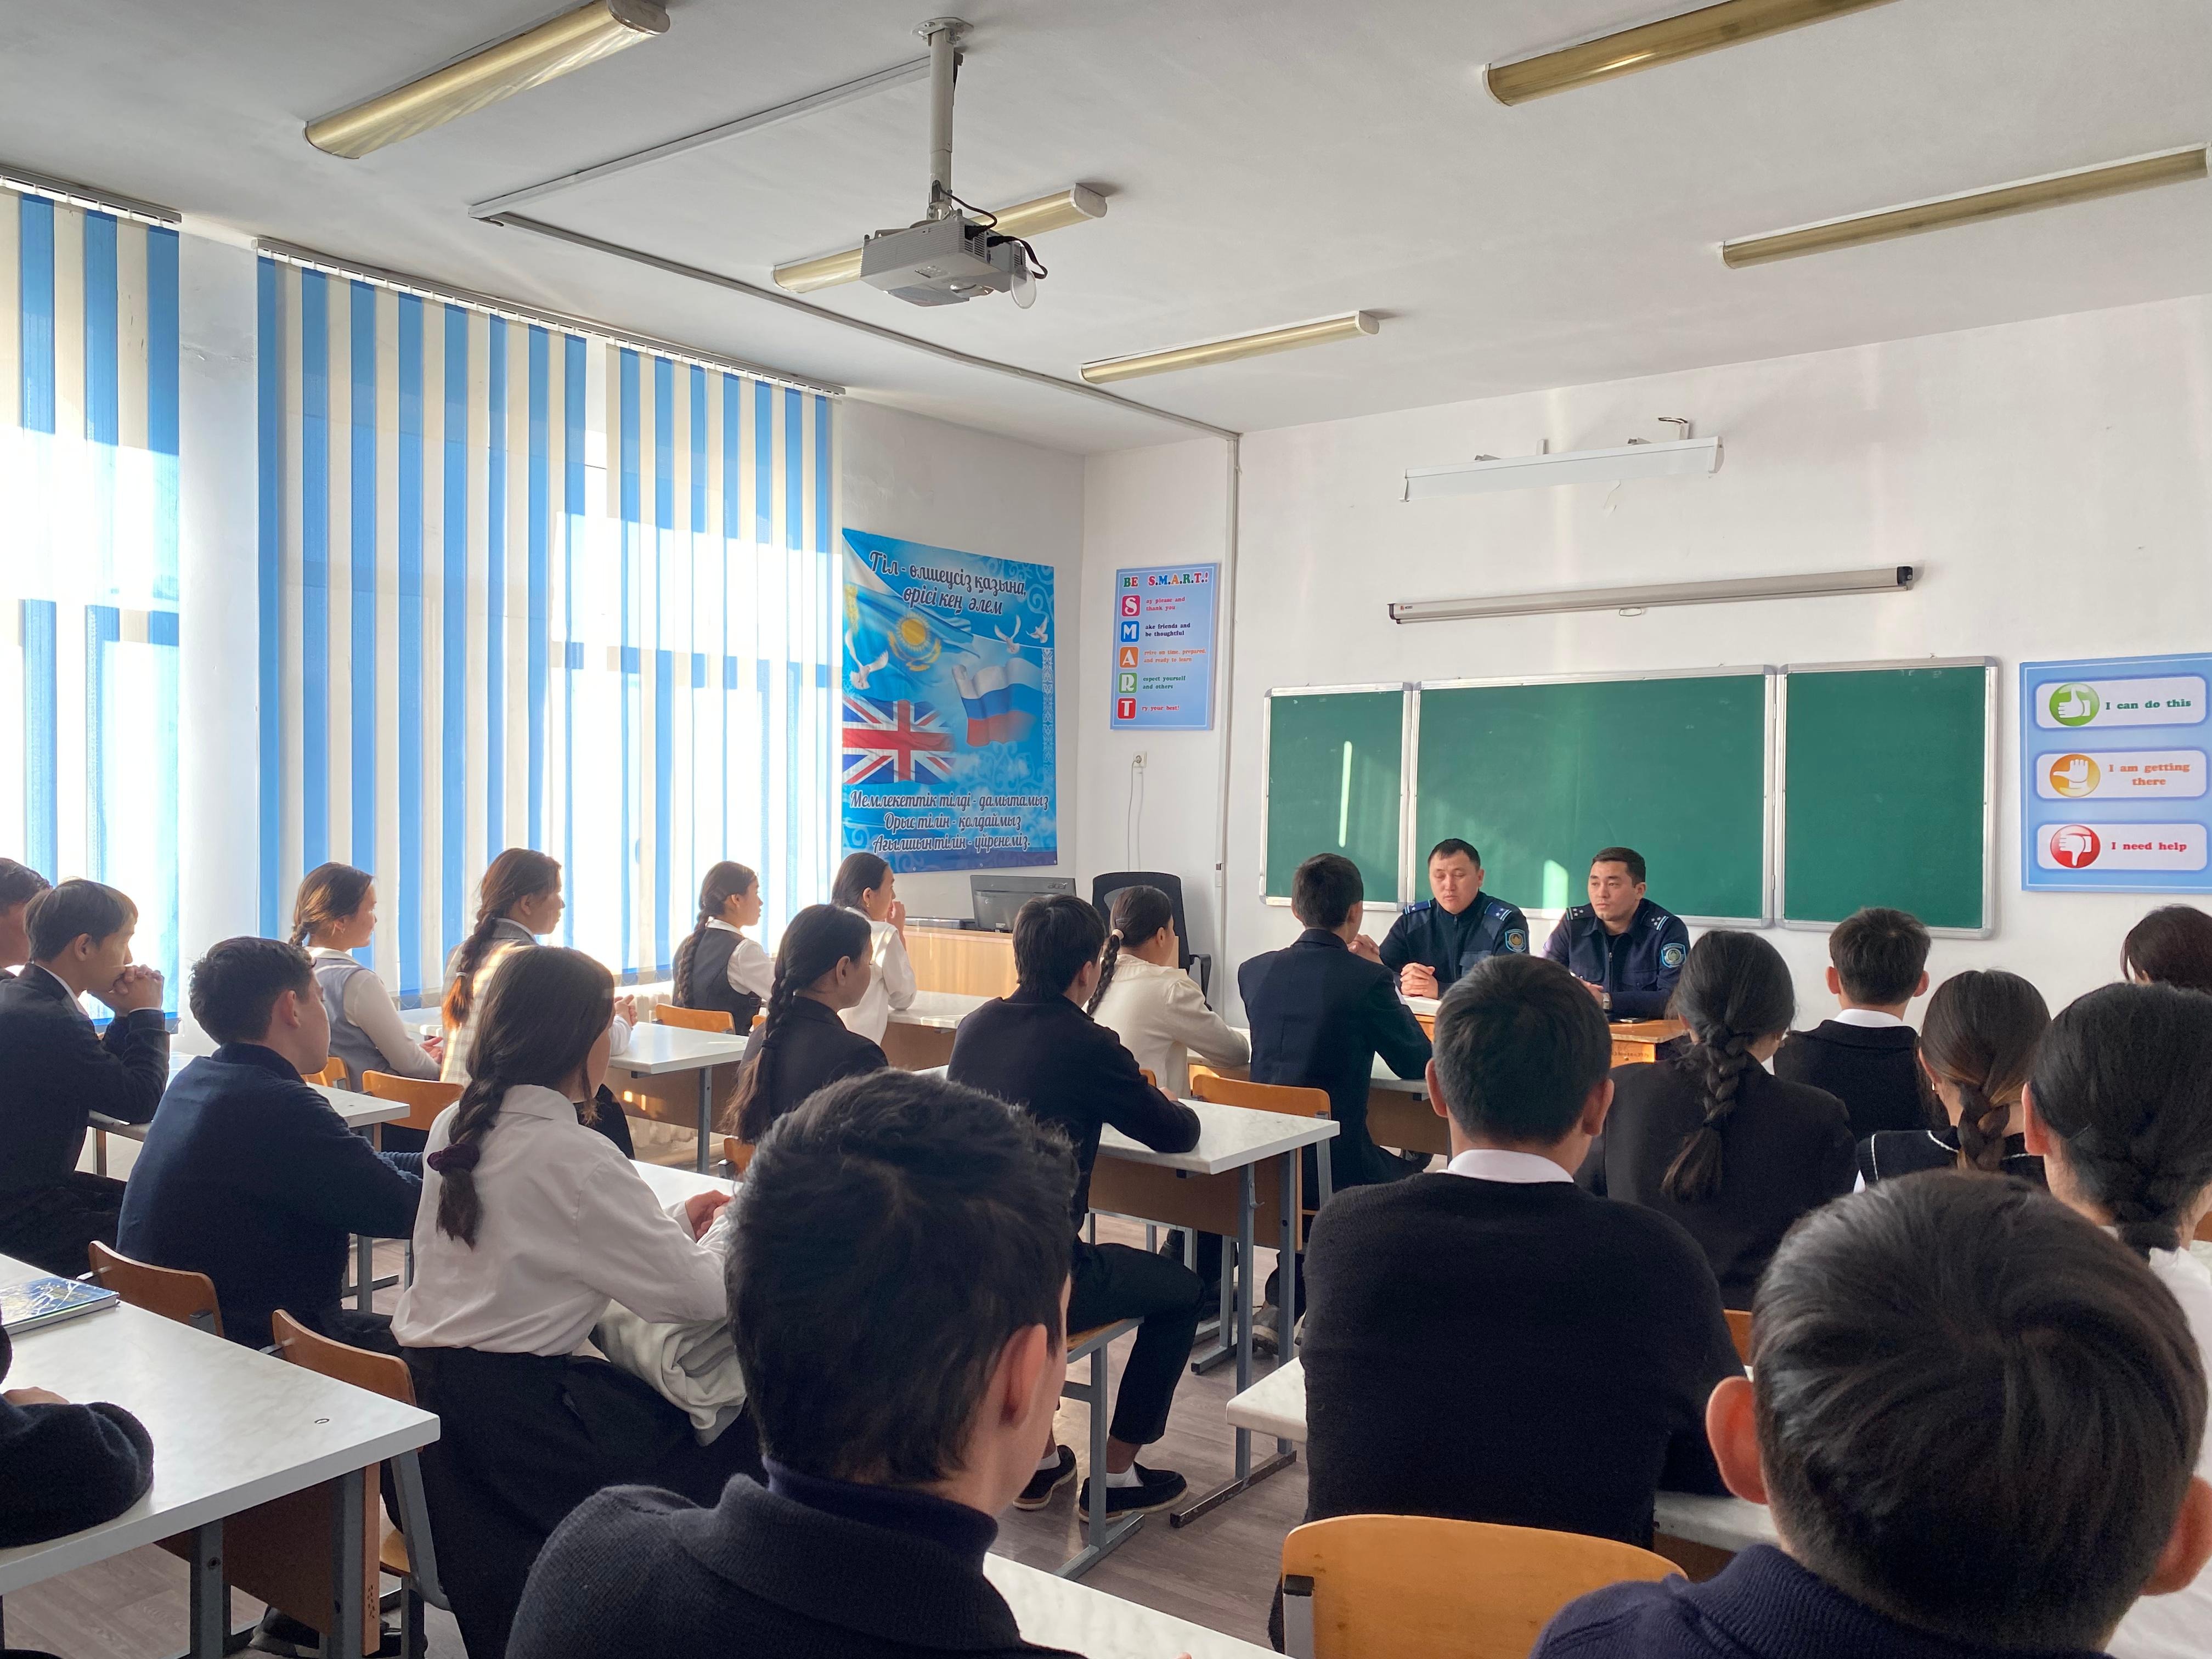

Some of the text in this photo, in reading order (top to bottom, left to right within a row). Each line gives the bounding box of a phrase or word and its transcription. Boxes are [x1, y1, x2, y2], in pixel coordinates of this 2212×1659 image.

[870, 551, 899, 575] Тіл
[910, 565, 972, 593] өлшеусіз
[975, 575, 1026, 597] қазына,
[1124, 572, 1208, 588] BE S.M.A.R.T.!
[903, 585, 1003, 614] өрісі кең әлем
[1125, 597, 1137, 615] S
[1124, 624, 1137, 639] M
[1122, 650, 1135, 665] A
[1121, 675, 1135, 691] R
[1121, 701, 1133, 716] T
[2106, 702, 2111, 710] I
[2145, 700, 2160, 708] do
[2166, 699, 2192, 707] this
[2145, 763, 2191, 773] getting
[2132, 777, 2166, 786] there
[850, 791, 937, 808] Мемлекеттік
[939, 792, 970, 811] тілді
[979, 795, 1048, 811] дамытамыз
[884, 812, 916, 833] Орыс
[917, 813, 950, 828] тілін
[958, 812, 1022, 832] қолдаймыз
[873, 835, 932, 853] Ағылшын
[934, 834, 966, 850] тілін
[2123, 842, 2152, 850] need
[2159, 842, 2187, 851] help
